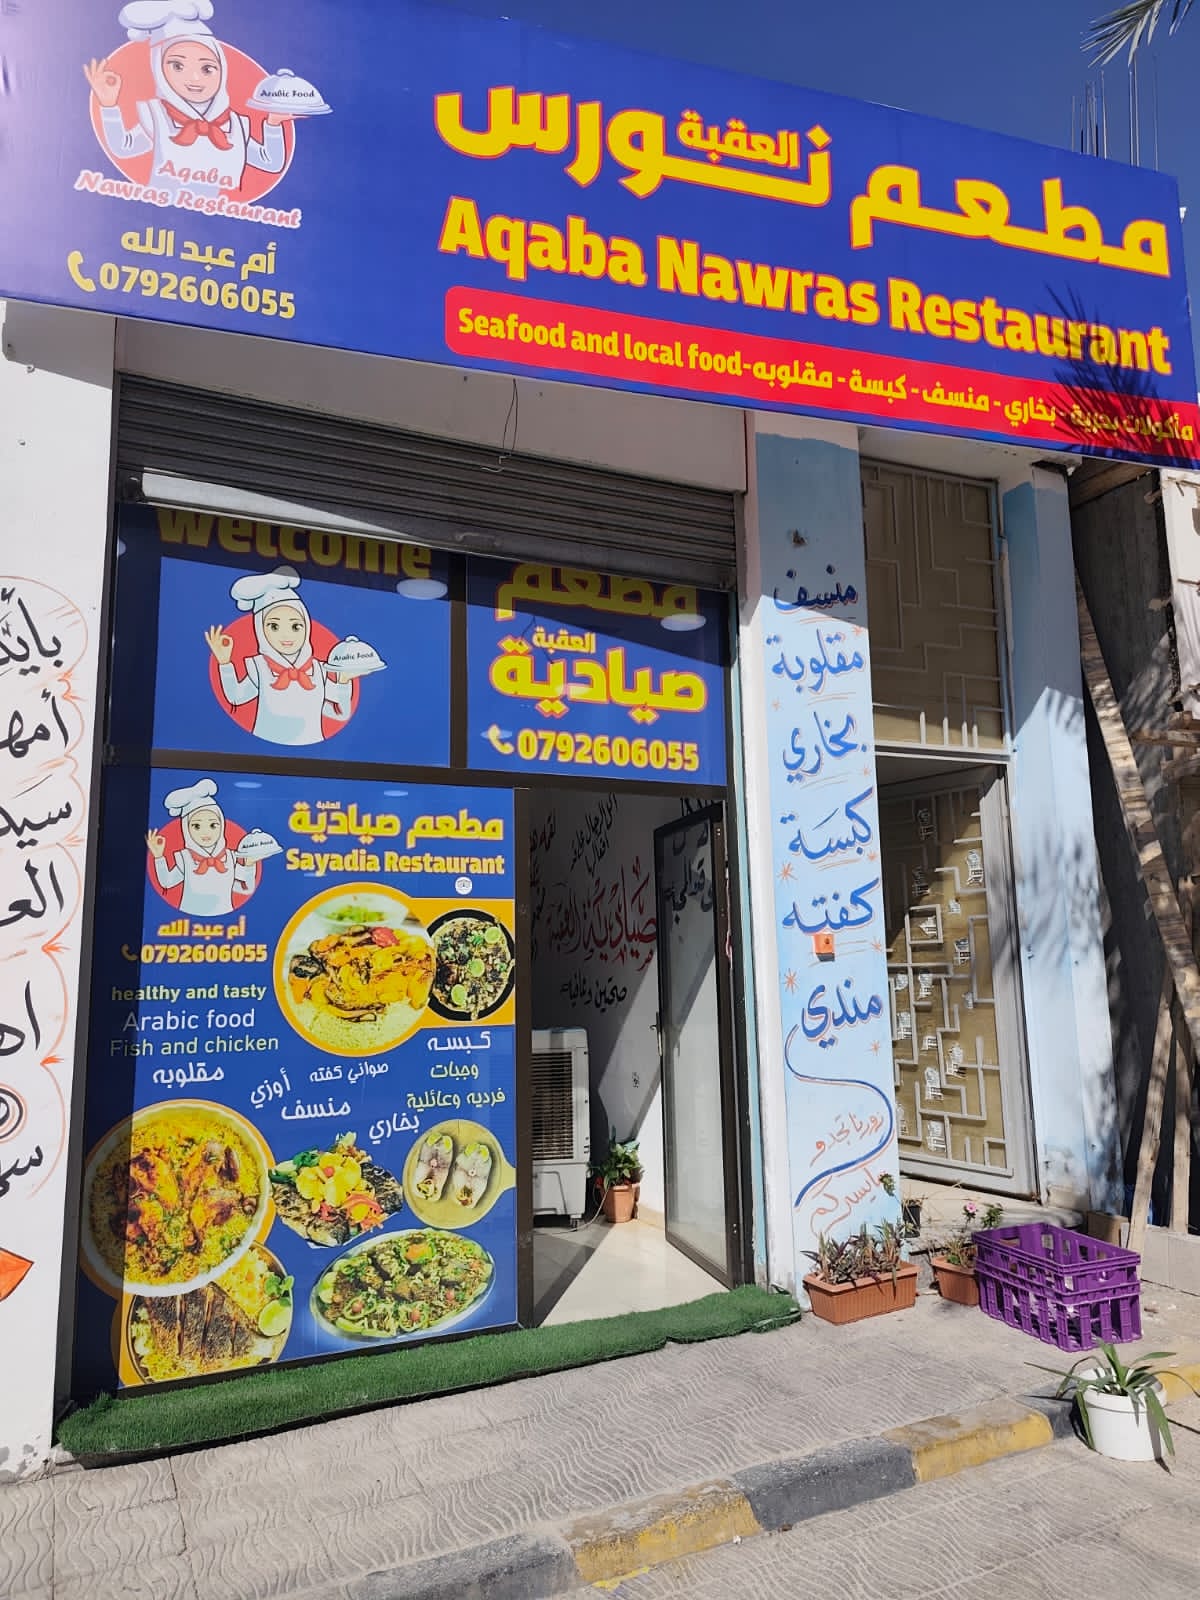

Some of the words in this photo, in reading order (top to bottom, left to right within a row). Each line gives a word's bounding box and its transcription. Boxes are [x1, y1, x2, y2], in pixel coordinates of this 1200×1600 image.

[260, 89, 289, 98] Arabic
[292, 89, 315, 98] Food
[434, 86, 832, 207] نورس
[677, 110, 800, 168] العقبة
[158, 160, 233, 188] Aqaba
[74, 170, 171, 207] Nawras
[176, 189, 302, 228] Restaurant
[849, 163, 1171, 277] مطعم
[121, 226, 175, 257] الله
[180, 241, 235, 271] عبد
[241, 242, 276, 280] أم
[100, 263, 296, 319] 0792606055
[439, 195, 648, 282] Aqaba
[656, 235, 881, 325] Nawras
[887, 277, 1173, 375] Restaurant
[458, 307, 566, 349] Seafood
[571, 328, 620, 357] and
[624, 333, 684, 368] local
[752, 360, 833, 389] مقلوبه
[849, 369, 907, 404] كبسة
[922, 381, 990, 412] منسف
[1004, 396, 1056, 427] بخاري
[495, 563, 697, 621] مطعم
[773, 564, 859, 611] منسف
[532, 626, 597, 654] العقبة
[766, 629, 865, 694] مقلوبة
[489, 635, 708, 725] صيادية
[517, 728, 699, 772] 0792606055
[782, 711, 868, 783] بخاري
[288, 801, 401, 844] صيادية
[406, 808, 504, 849] مطعم
[286, 848, 380, 877] Sayadia
[384, 851, 505, 875] Restaurant
[157, 919, 190, 937] الله
[191, 921, 224, 940] عبد
[226, 915, 246, 939] أم
[140, 943, 268, 963] 0792606055
[111, 985, 180, 1002] healthy
[186, 984, 218, 999] and
[223, 983, 267, 1001] tasty
[122, 1009, 199, 1032] Arabic
[207, 1008, 255, 1029] food
[801, 979, 883, 1049] مندي
[110, 1038, 153, 1057] Fish
[161, 1037, 198, 1055] and
[204, 1034, 279, 1053] chicken
[427, 1030, 491, 1054] كبسه
[152, 1062, 224, 1089] مقلوبه
[309, 1065, 343, 1082] كفته
[347, 1061, 389, 1084] صواني
[430, 1060, 479, 1080] وجبات
[250, 1067, 291, 1108] أوزي
[406, 1089, 461, 1112] وعائلية
[466, 1087, 506, 1108] فرديه
[281, 1097, 351, 1121] منسف
[368, 1112, 421, 1145] بخاري
